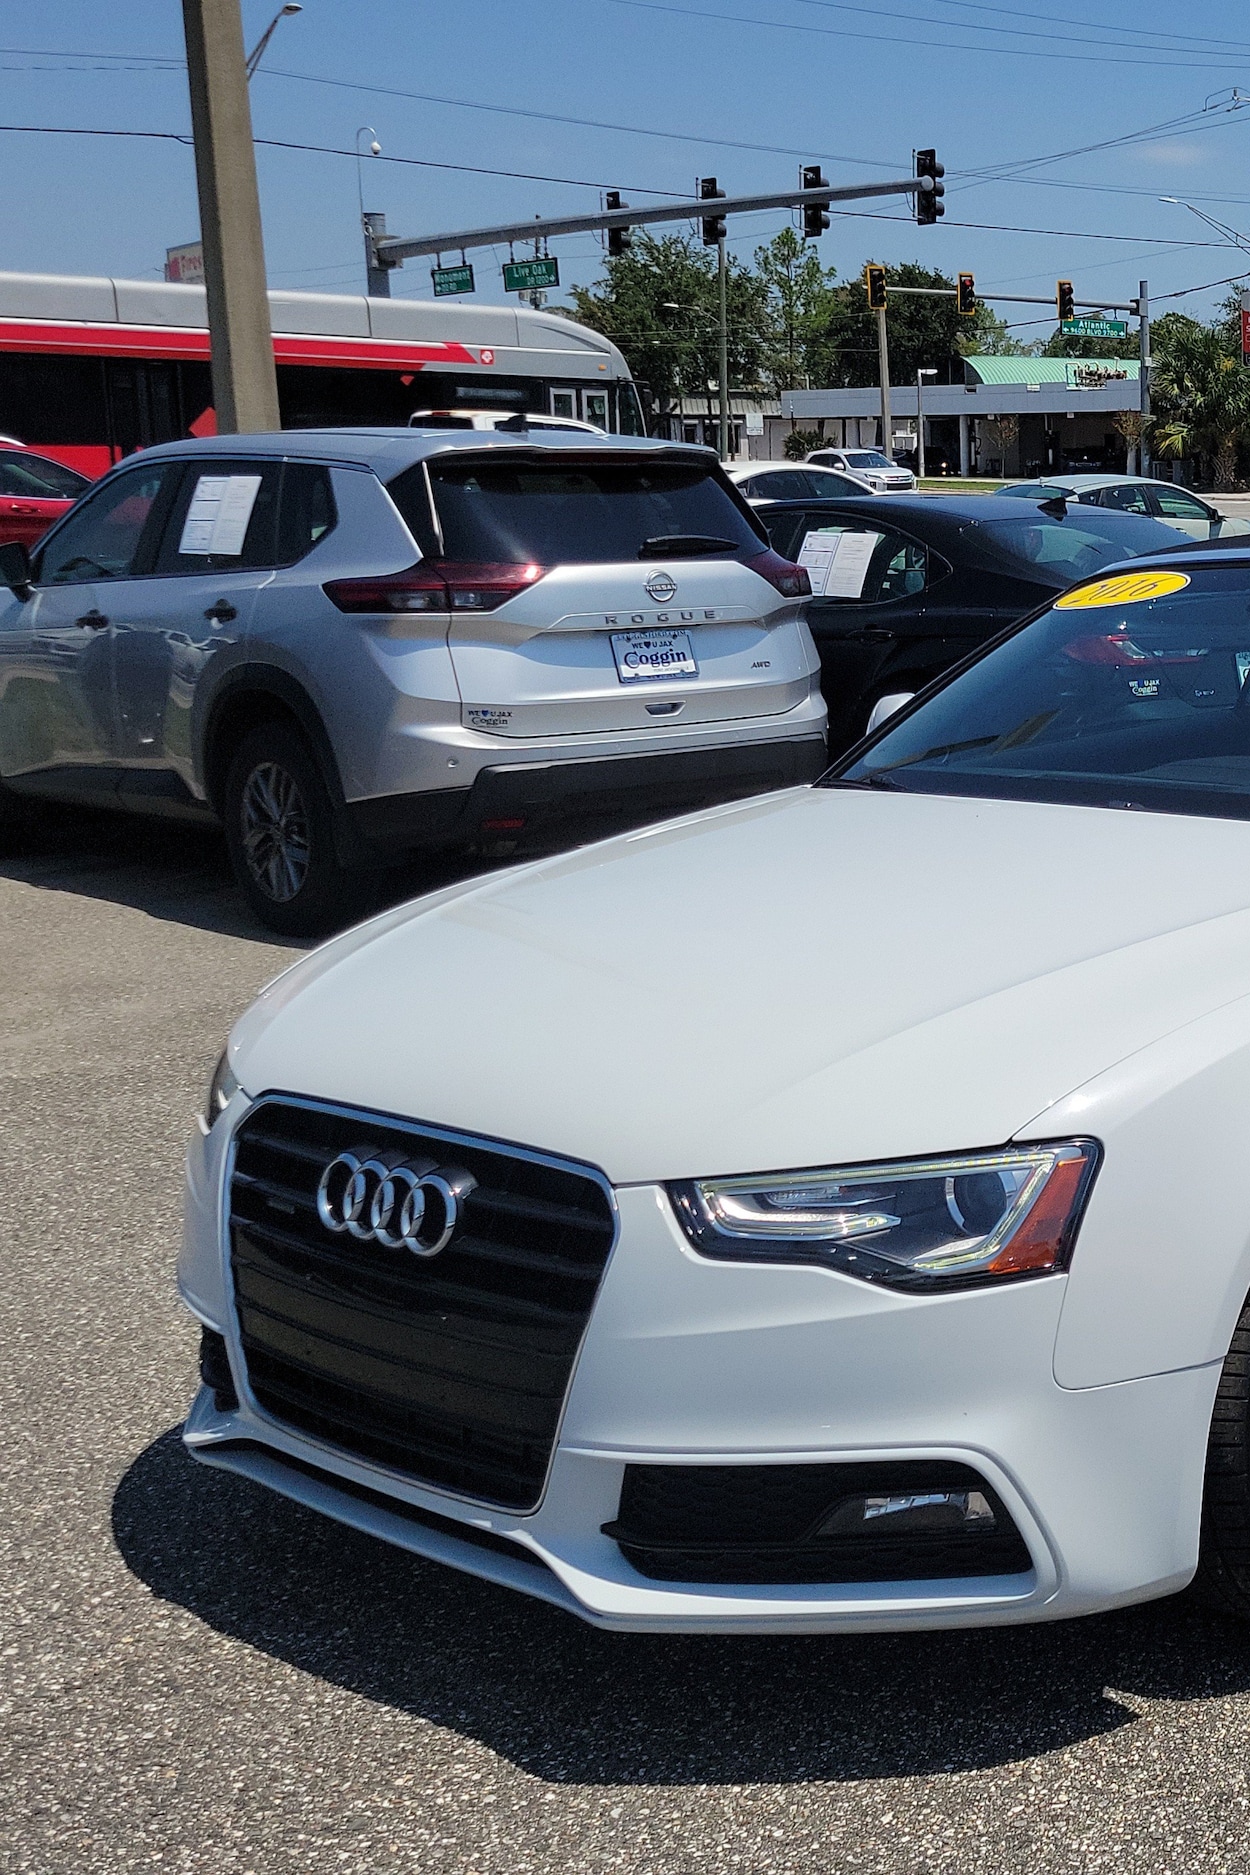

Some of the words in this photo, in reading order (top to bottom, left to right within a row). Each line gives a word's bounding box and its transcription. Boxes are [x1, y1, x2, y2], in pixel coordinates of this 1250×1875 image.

[513, 267, 530, 278] Live
[532, 264, 547, 275] Oak
[1078, 320, 1111, 330] Atlantic
[645, 583, 677, 592] NISSAN
[1067, 577, 1177, 605] 2016
[604, 610, 717, 625] ROGUE
[624, 649, 687, 669] Coggin
[751, 661, 771, 669] AWD
